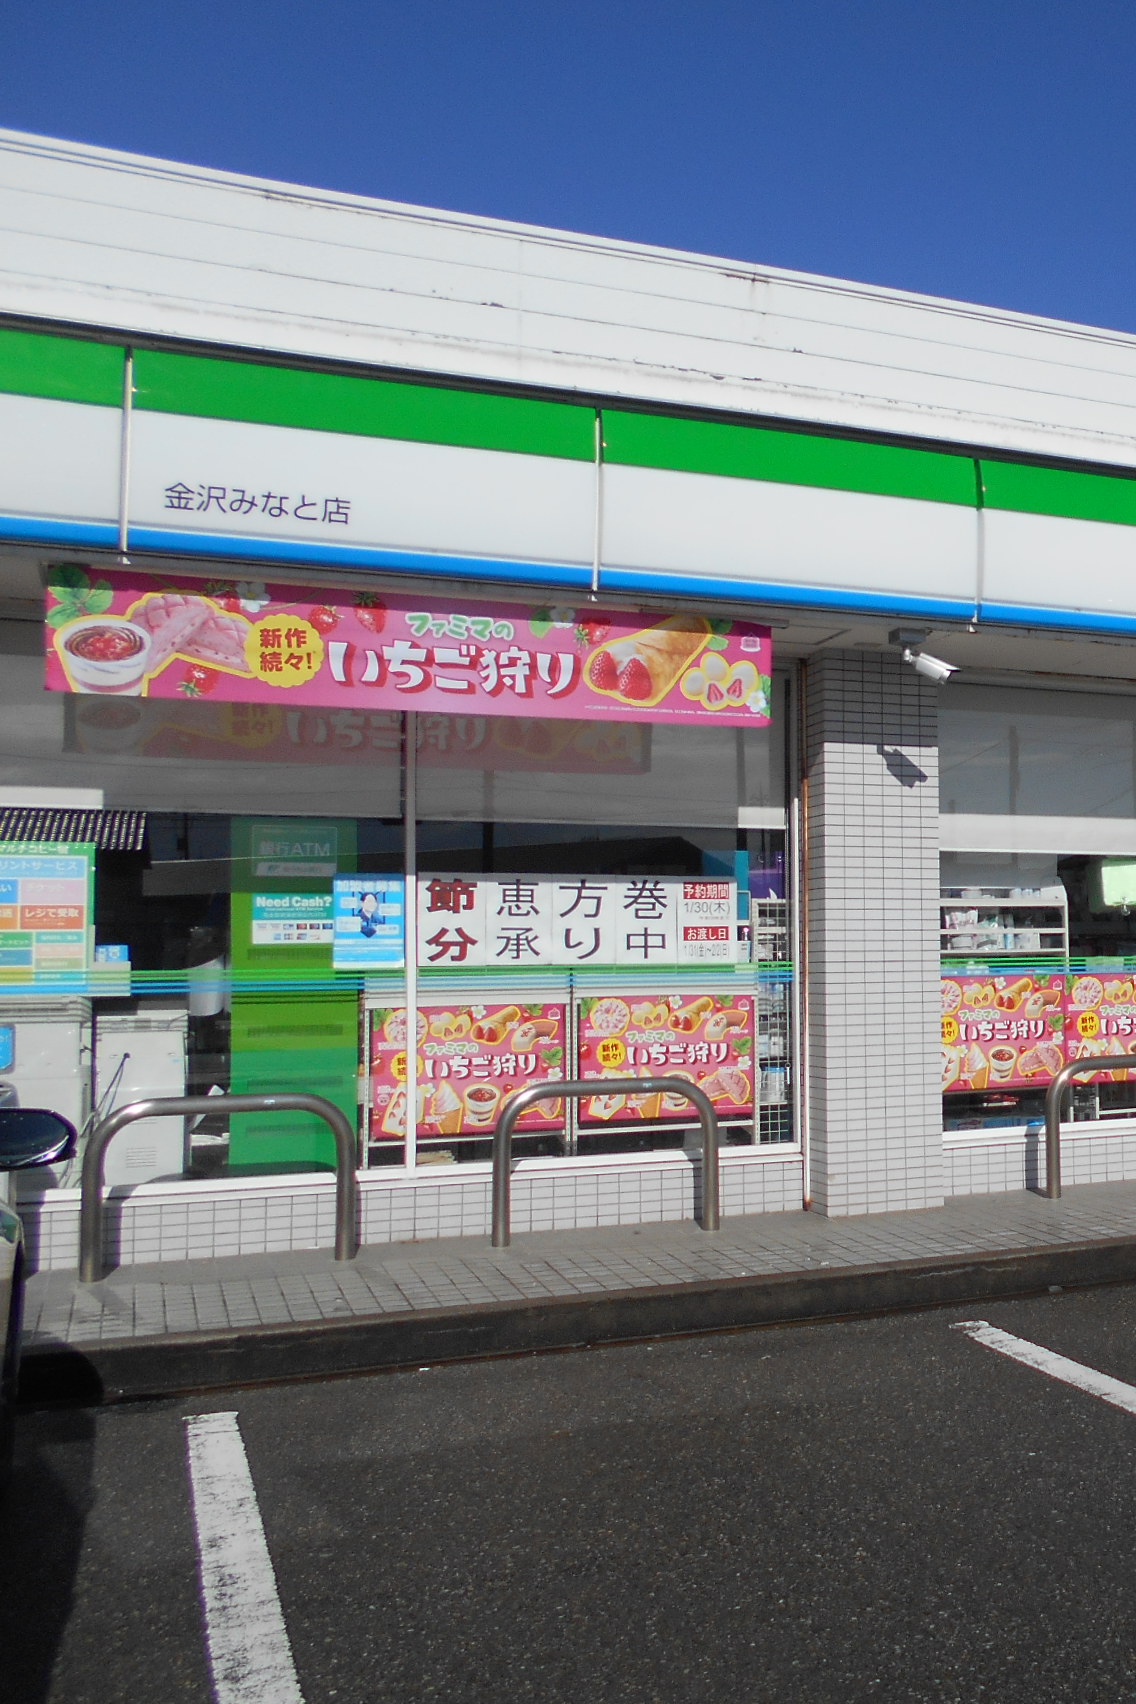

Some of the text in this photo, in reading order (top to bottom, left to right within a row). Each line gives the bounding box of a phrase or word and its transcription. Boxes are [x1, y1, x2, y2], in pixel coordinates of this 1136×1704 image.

[164, 482, 351, 525] 金沢みなと店
[259, 628, 307, 648] 新作
[405, 612, 514, 641] ファミマの
[259, 652, 313, 672] 続々!
[328, 640, 577, 695] いちご狩り
[256, 896, 332, 907] Need Cash?
[497, 879, 669, 920] 恵方巻
[684, 884, 729, 898] 予約期間
[496, 926, 667, 961] 承り中
[687, 927, 727, 940] お渡し日
[960, 1019, 1045, 1042] いちご狩り
[627, 1041, 728, 1066] いちご狩り
[425, 1053, 537, 1080] いちご狩り
